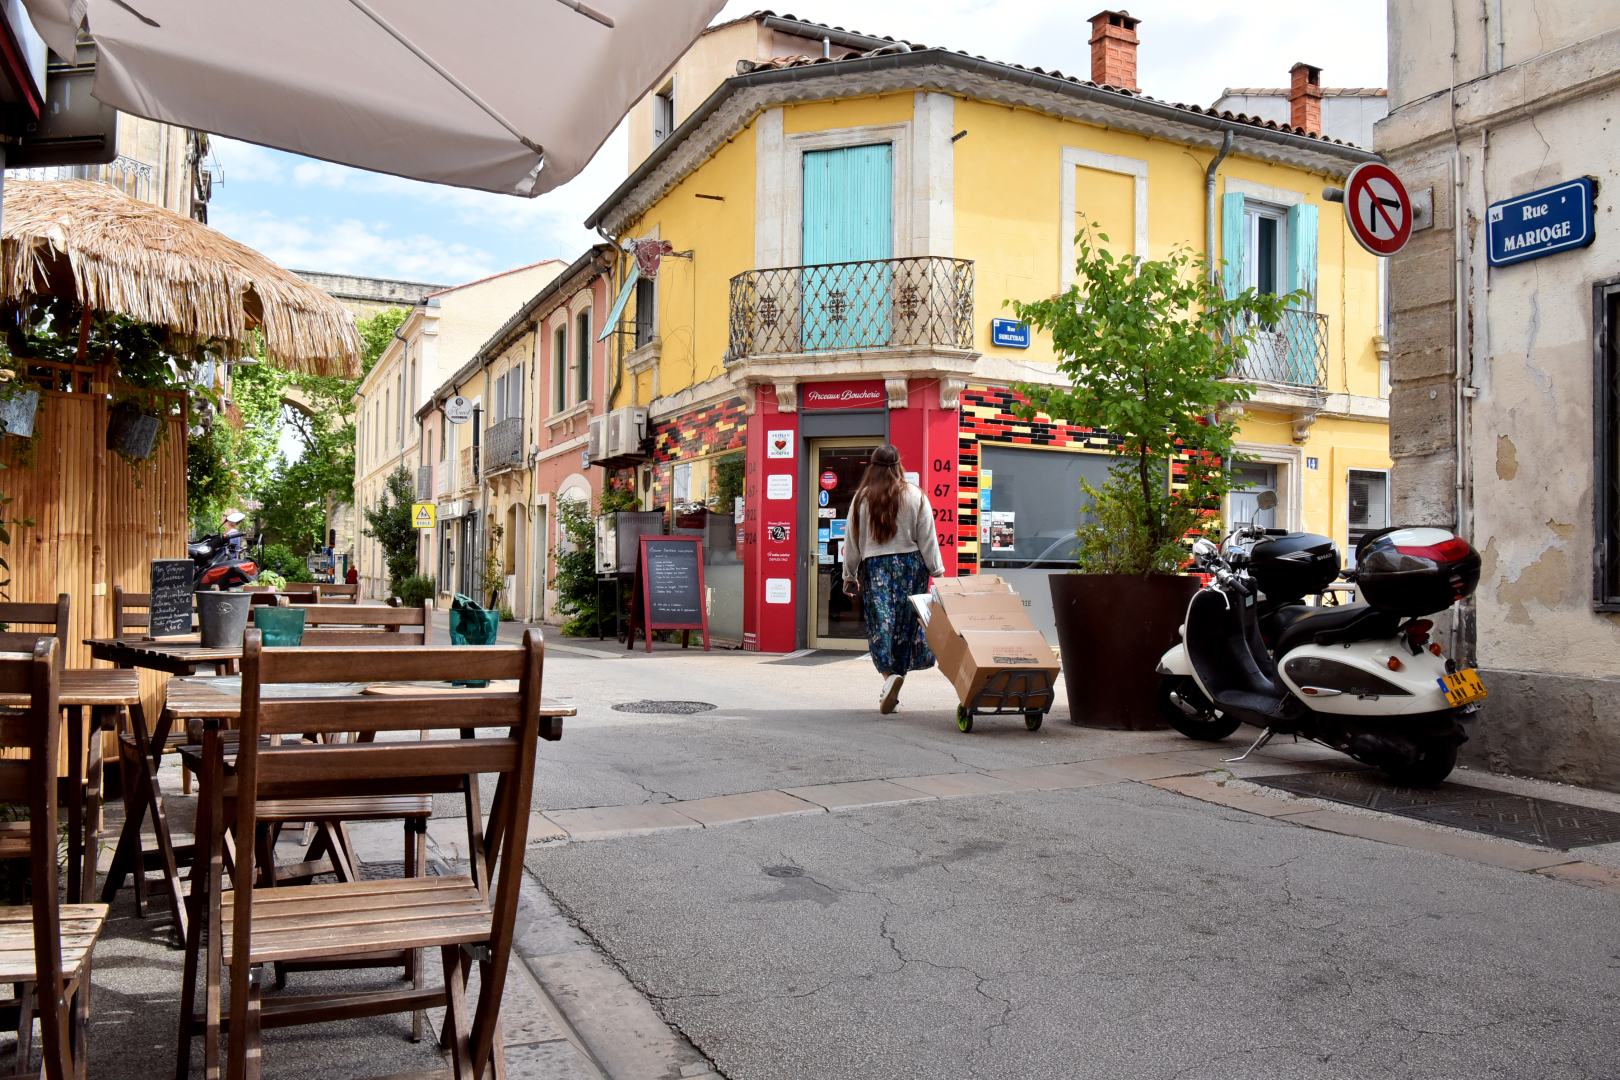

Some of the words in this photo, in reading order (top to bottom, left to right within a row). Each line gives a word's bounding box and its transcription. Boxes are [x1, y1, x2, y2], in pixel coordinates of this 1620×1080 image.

[1492, 212, 1500, 222] M
[1522, 203, 1549, 221] Rue
[1503, 220, 1571, 252] MARIOGE
[808, 391, 840, 401] Arceaux
[840, 389, 880, 400] Boucherie
[933, 459, 951, 472] 04
[933, 484, 950, 497] 67
[932, 508, 953, 522] 921
[1469, 682, 1484, 695] 34
